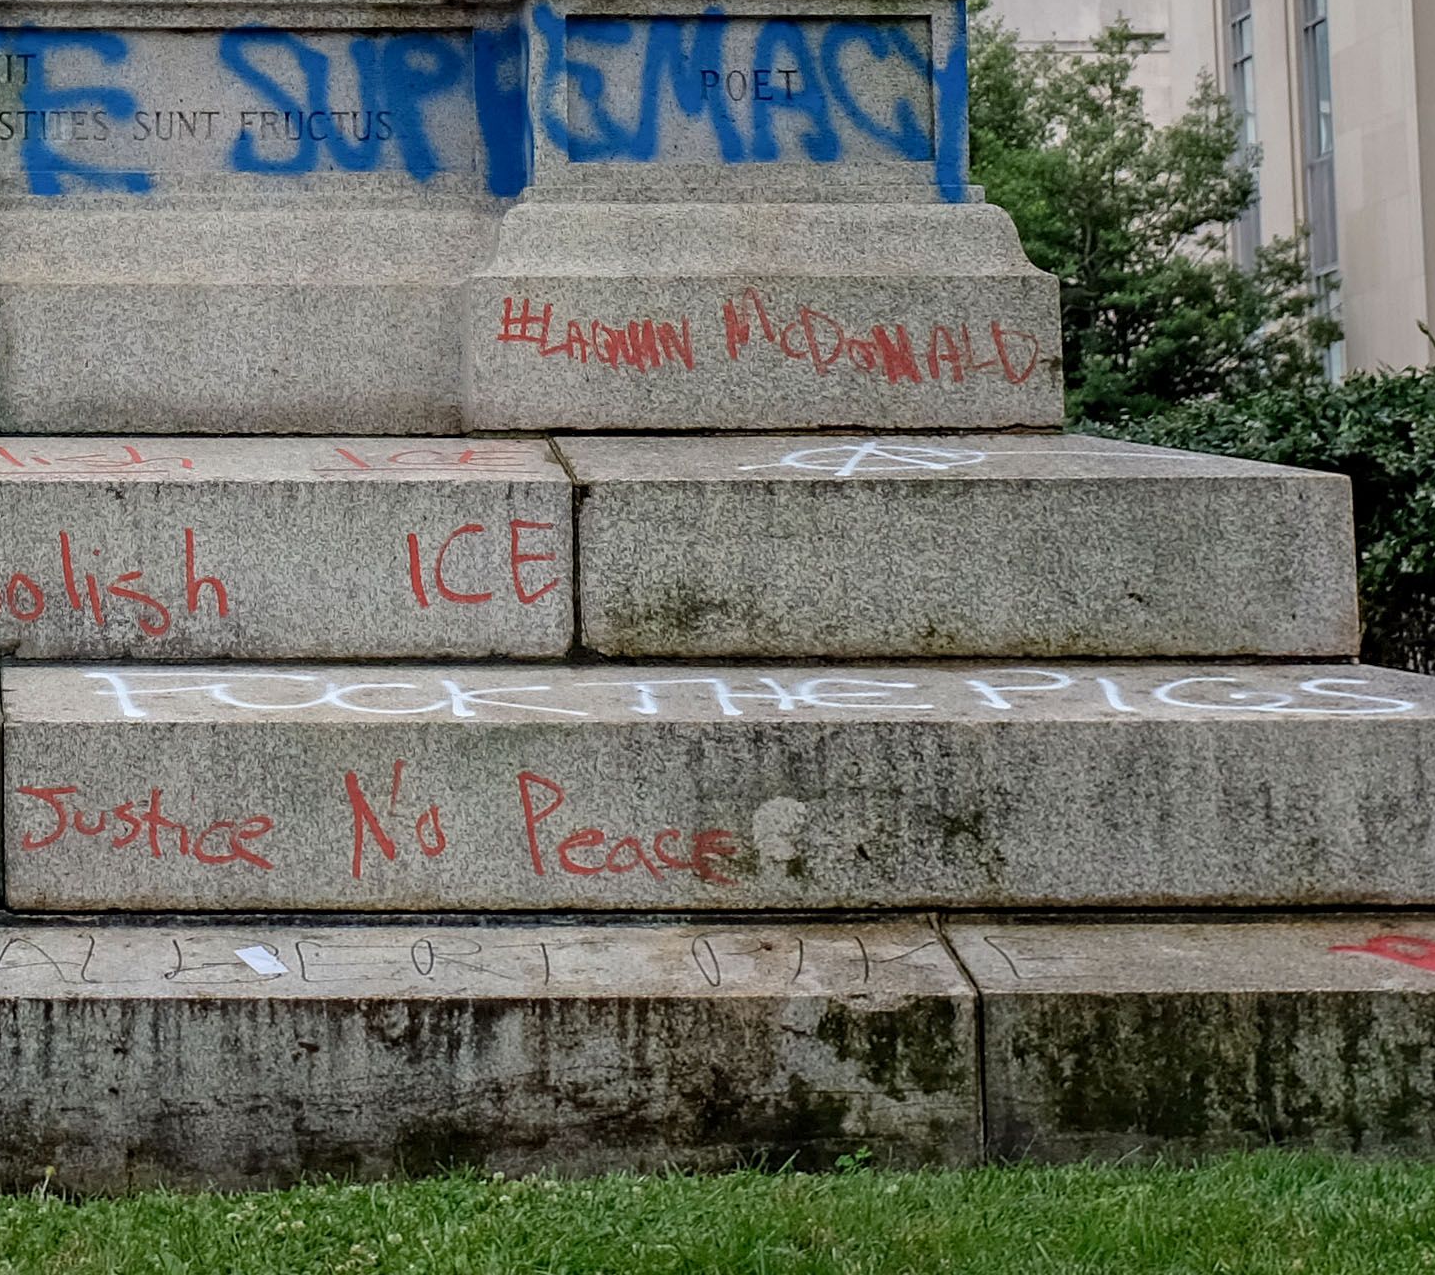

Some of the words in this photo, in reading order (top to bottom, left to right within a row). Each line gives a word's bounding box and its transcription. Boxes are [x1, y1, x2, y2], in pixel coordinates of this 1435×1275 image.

[217, 1, 969, 203] SUPREMACY
[699, 69, 799, 102] POET
[132, 109, 221, 141] SUNT
[237, 109, 394, 141] FRUCTUS
[404, 519, 562, 608] ICE
[82, 670, 589, 719] FUCK
[573, 675, 935, 717] THE
[963, 669, 1417, 715] PIGS
[15, 782, 279, 872] Justice
[343, 758, 447, 881] No
[516, 770, 741, 888] Peace
